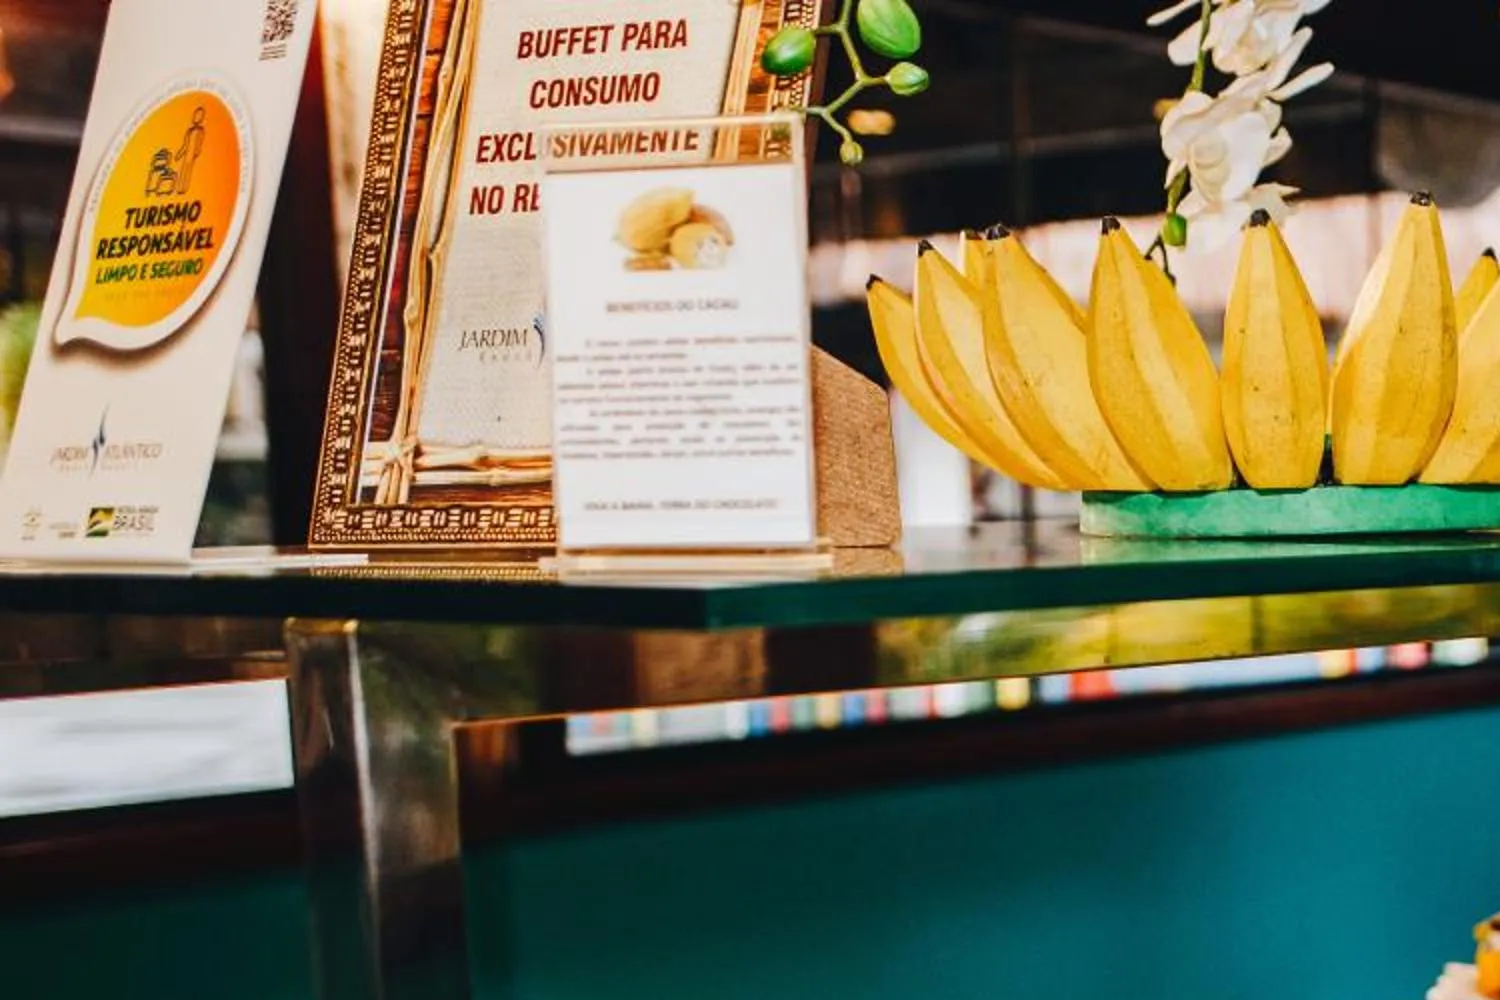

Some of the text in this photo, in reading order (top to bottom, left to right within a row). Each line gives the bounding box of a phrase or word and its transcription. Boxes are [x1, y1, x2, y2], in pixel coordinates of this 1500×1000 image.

[517, 19, 688, 60] BUFFET PARA
[529, 71, 661, 109] CONSUMO
[469, 185, 504, 215] NO
[125, 201, 202, 230] TURISMO
[96, 223, 214, 261] RESPONSÁVEL
[96, 257, 204, 285] LIMPO E SEGURO
[458, 328, 528, 352] JARDIM
